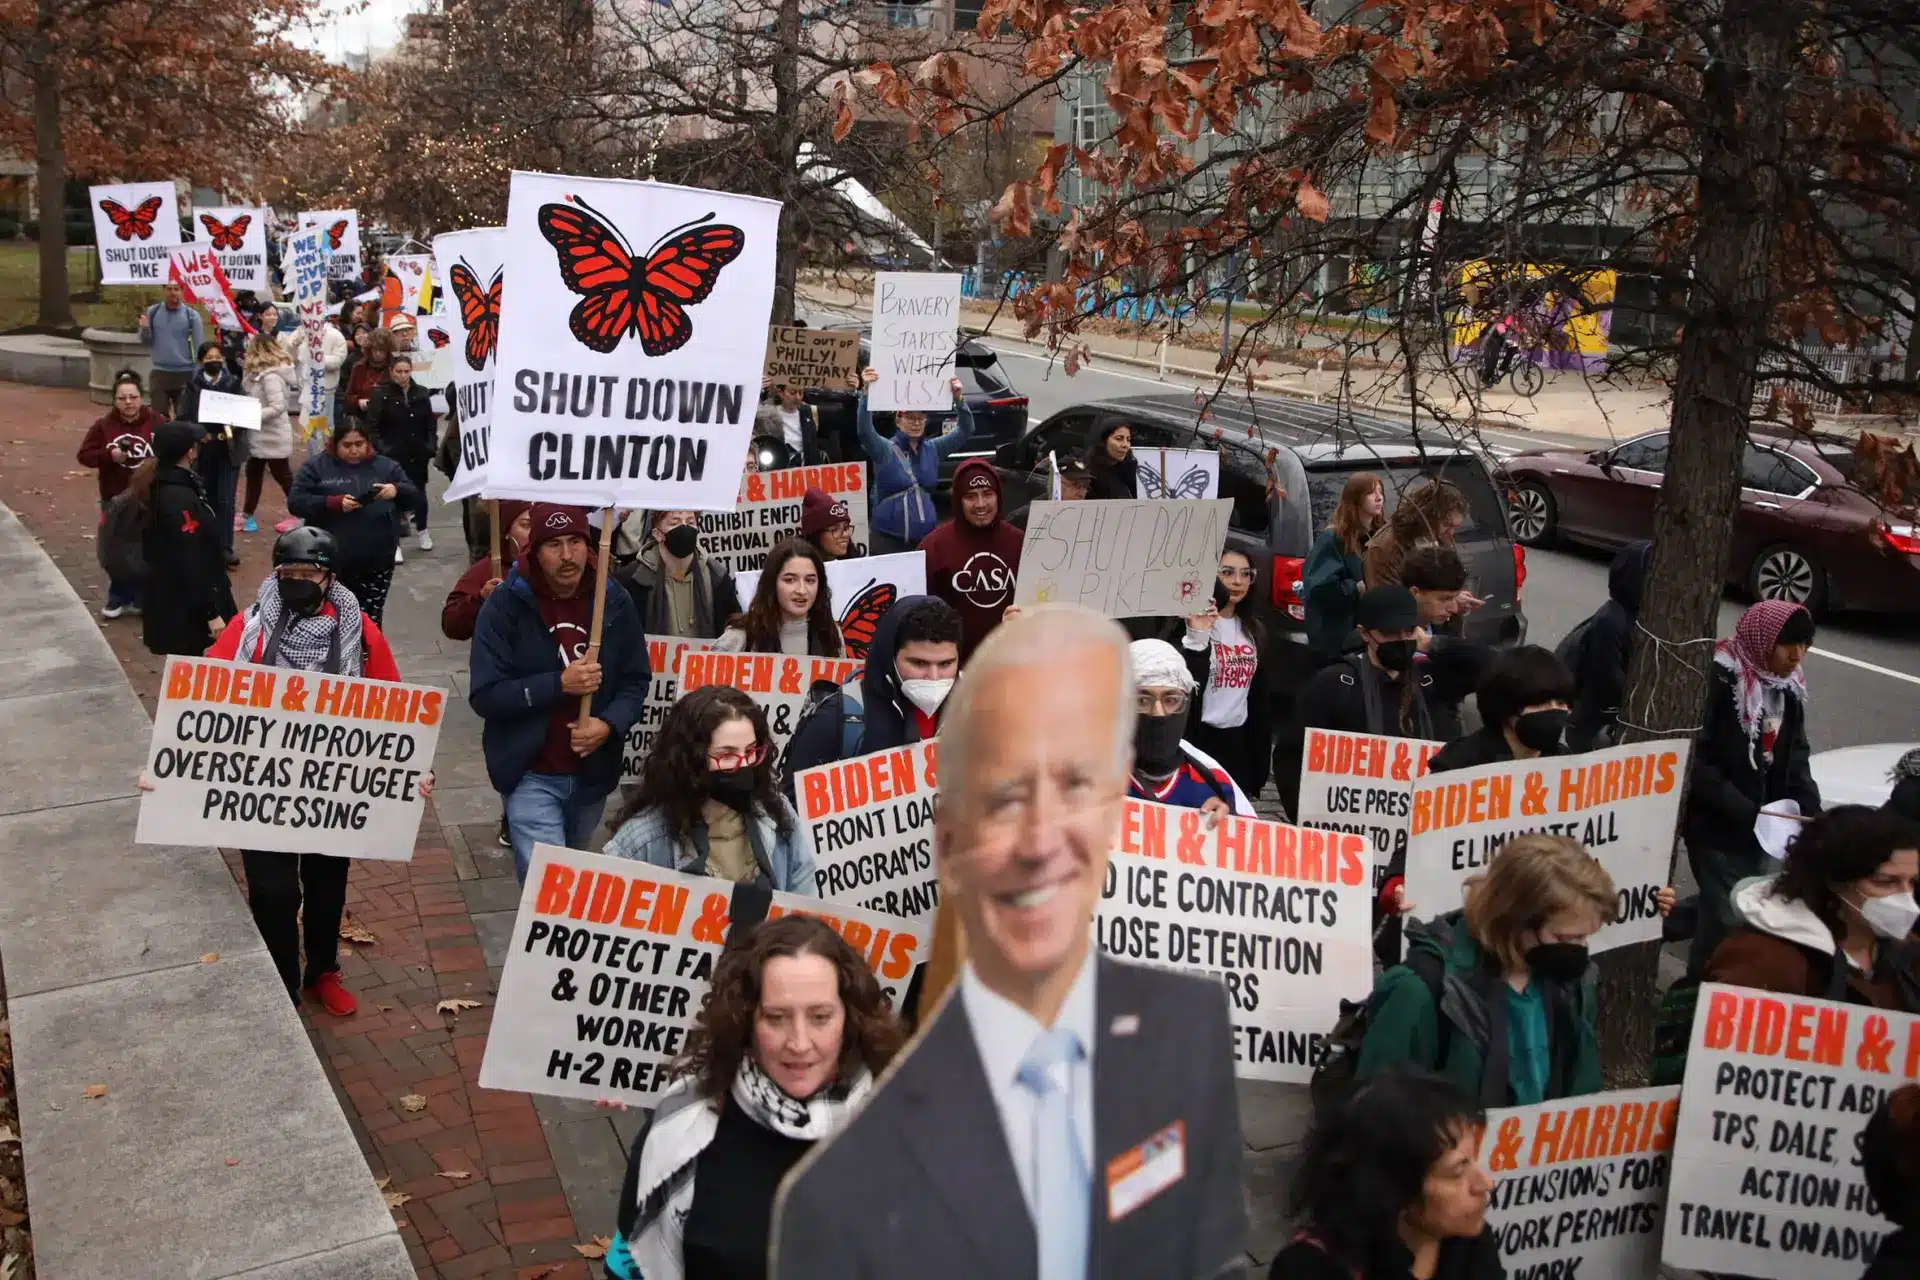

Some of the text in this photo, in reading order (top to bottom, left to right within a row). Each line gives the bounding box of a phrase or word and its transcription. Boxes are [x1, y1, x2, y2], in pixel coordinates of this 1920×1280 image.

[105, 246, 168, 262] SHUT DOW
[179, 250, 209, 274] WE
[229, 254, 261, 267] DOWN
[293, 235, 316, 253] WE
[130, 263, 158, 278] PIKE
[223, 268, 254, 280] NTON
[300, 300, 323, 315] WE
[880, 282, 954, 316] BRAVERY
[772, 327, 807, 345] ICE
[813, 338, 836, 347] OUT
[776, 346, 836, 365] PHILLY!
[880, 323, 948, 351] STARTS
[768, 362, 850, 378] SANCTUARY
[788, 377, 826, 386] CITY!
[459, 381, 487, 423] SHUT
[514, 369, 743, 424] SHUT DOWN
[463, 427, 489, 471] CLI
[528, 431, 708, 481] CLINTON
[747, 464, 862, 503] & HARRIS
[546, 514, 573, 529] CASA
[698, 505, 802, 533] ROHIBIT ENFO
[1025, 505, 1220, 571] #SHUT DOWN
[700, 532, 769, 553] REMOVAL
[952, 567, 1016, 592] CASA
[1078, 568, 1163, 615] PIKE
[167, 661, 442, 726] BIDEN & HARRIS
[684, 655, 774, 693] BIDEN
[779, 658, 803, 694] &
[177, 710, 415, 762] CODIFY IMPROVED
[1308, 730, 1388, 779] BIDEN
[1391, 742, 1412, 781] &
[154, 748, 421, 801] OVERSEAS REFUGEE
[804, 749, 916, 820] BIDEN
[1411, 752, 1678, 836] BIDEN & HARRIS
[203, 789, 370, 830] PROCESSING
[1327, 786, 1362, 813] USE
[812, 797, 935, 854] FRONT LOA
[1583, 811, 1619, 849] ALL
[814, 839, 931, 899] PROGRAMS
[1177, 811, 1207, 867] &
[1216, 817, 1364, 887] HARRIS
[535, 863, 690, 937] BIDEN
[691, 892, 732, 945] &
[1128, 866, 1168, 908] ICE
[1177, 872, 1338, 927] CONTRACTS
[1616, 884, 1661, 926] ONS
[525, 920, 713, 982] PROTECT FA
[1097, 914, 1323, 976] LOSE DETENTION
[551, 968, 691, 1018] & OTHER
[576, 1014, 684, 1056] WORKE
[1704, 991, 1848, 1067] BIDEN
[1856, 1014, 1895, 1074] &
[546, 1049, 668, 1093] H-2 REF
[1715, 1061, 1836, 1112] PROTECT
[1489, 1096, 1680, 1172] & HARRIS
[1712, 1110, 1760, 1152] TPS,
[1769, 1120, 1838, 1167] DALE,
[1488, 1154, 1668, 1210] XTENSIONS FOR
[1740, 1166, 1841, 1208] ACTION
[1553, 1202, 1660, 1248] PERMITS
[1680, 1202, 1882, 1264] TRAVEL ON ADV
